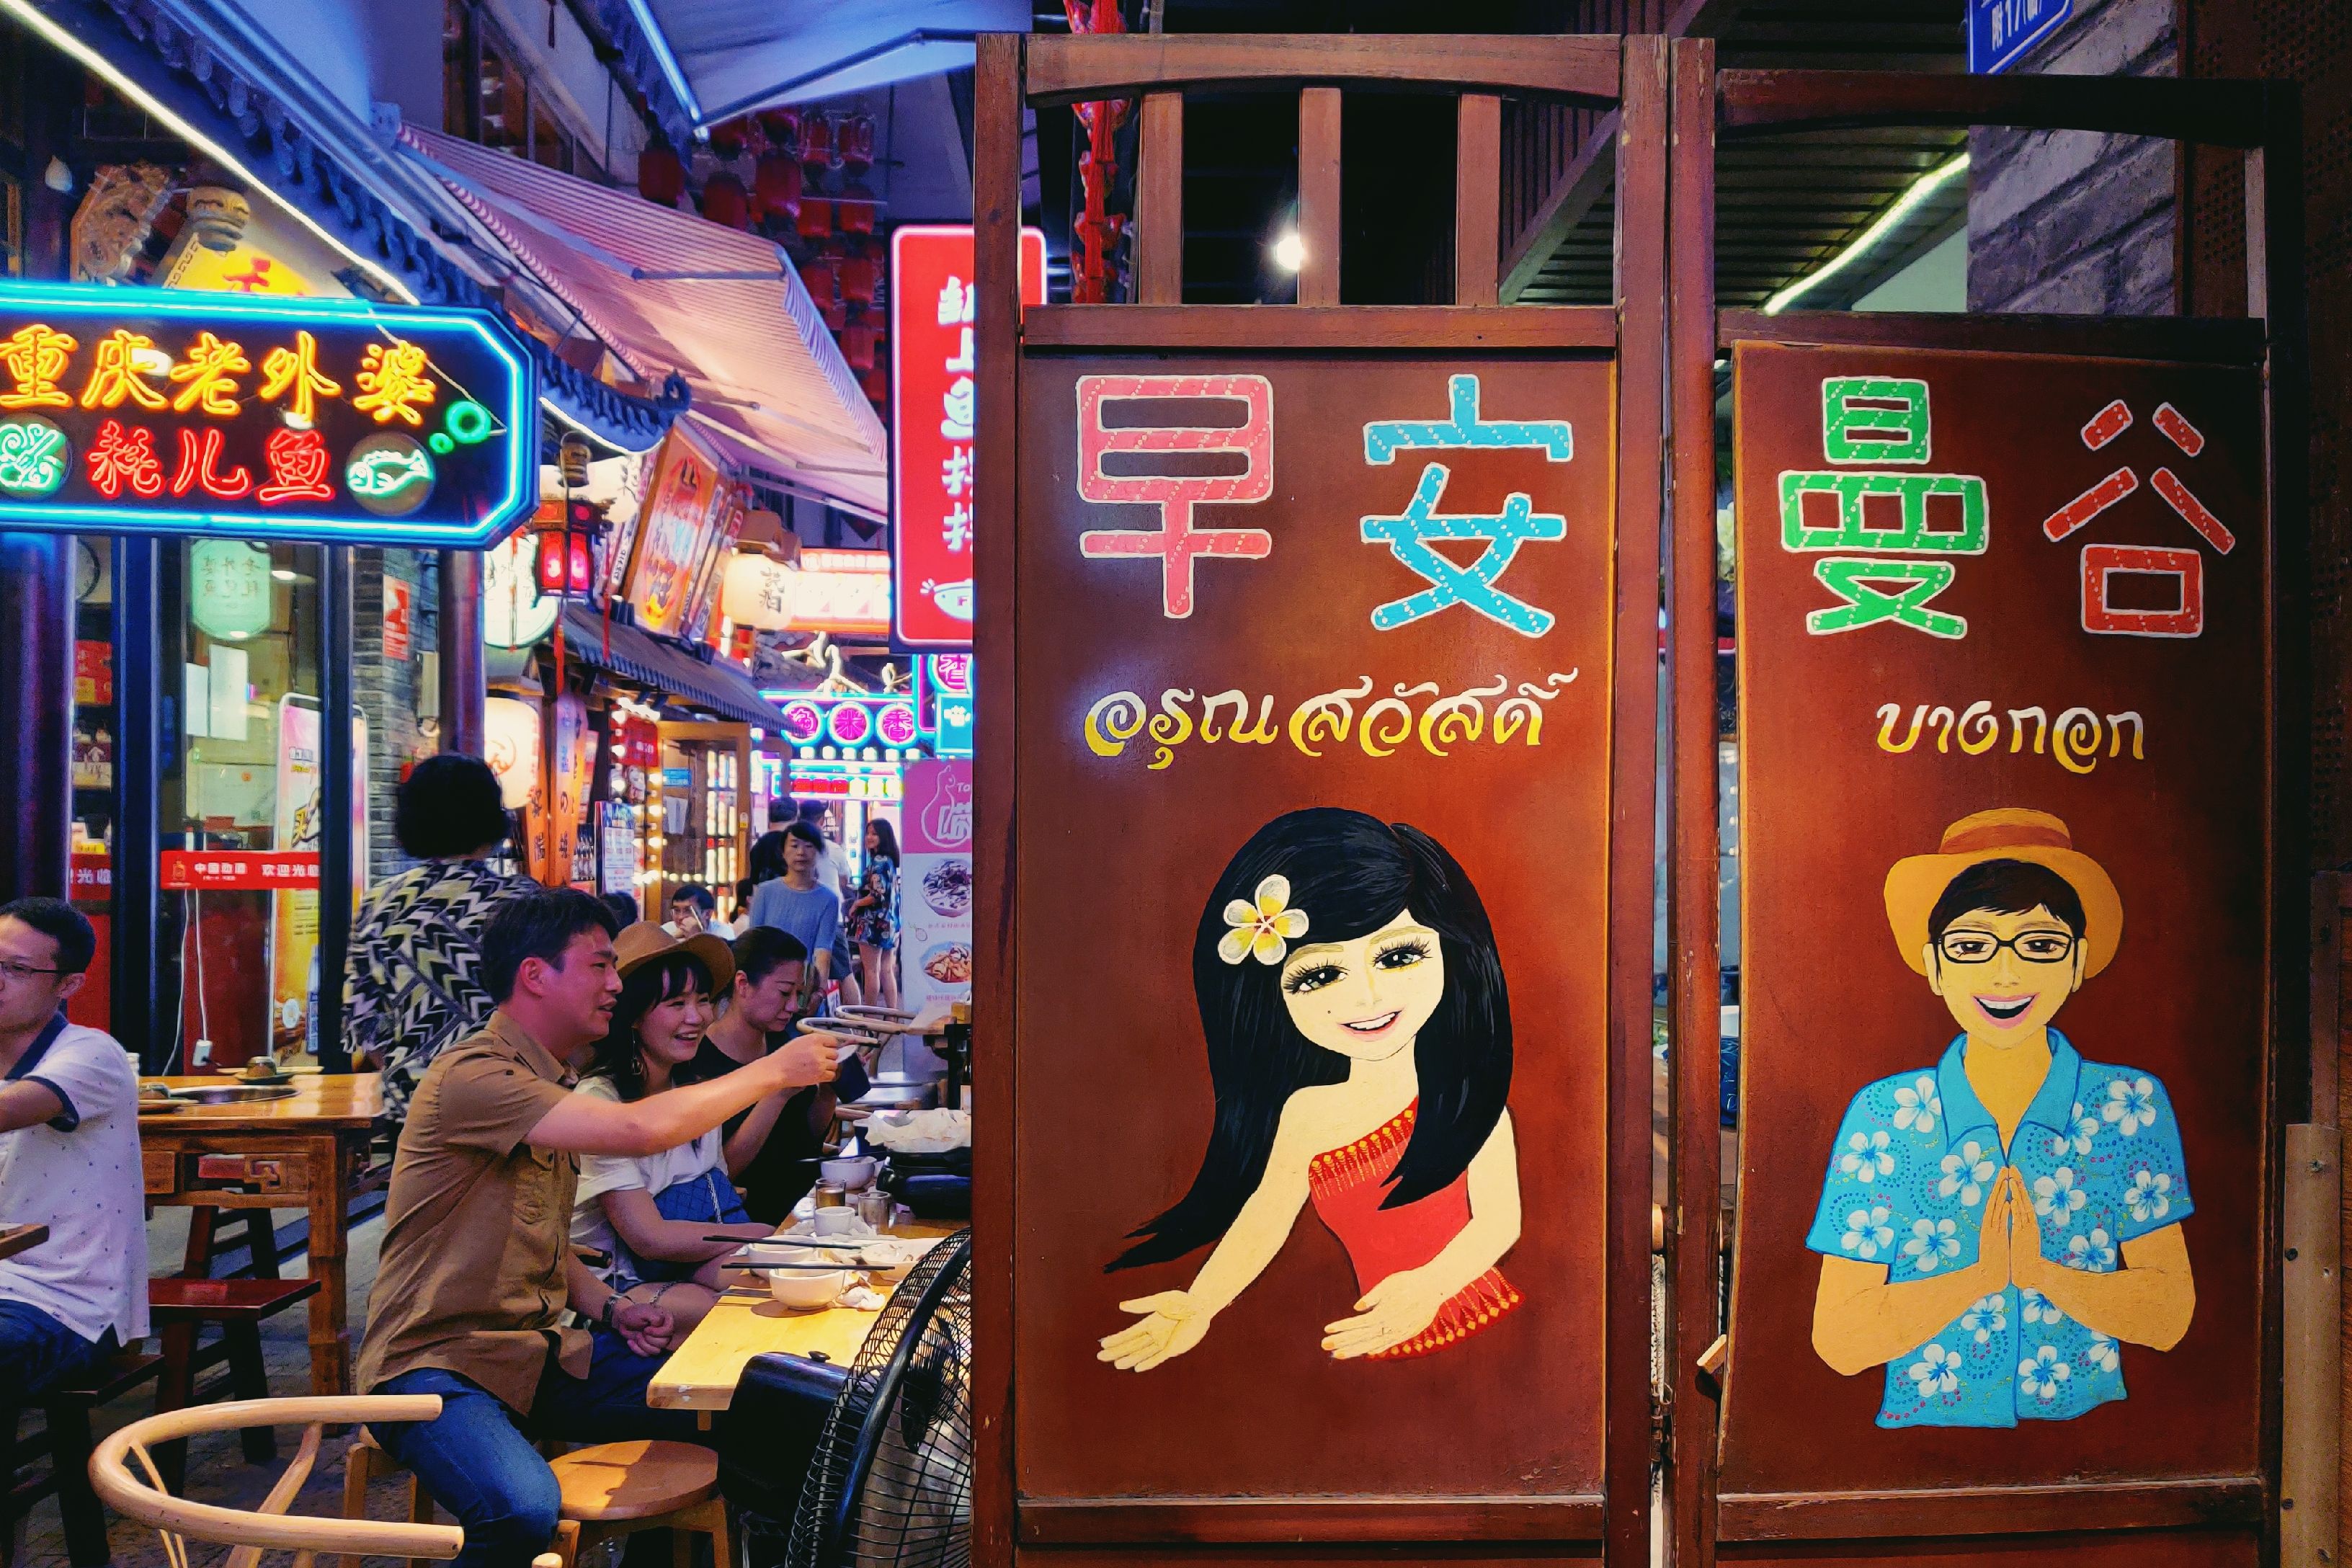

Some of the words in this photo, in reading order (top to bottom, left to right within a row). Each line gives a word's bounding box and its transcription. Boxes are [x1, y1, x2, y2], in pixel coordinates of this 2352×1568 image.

[0, 322, 437, 427] 重庆老外婆
[85, 419, 336, 505] 耗儿鱼
[1075, 373, 1574, 639] 早安
[1778, 375, 2236, 640] 曼谷
